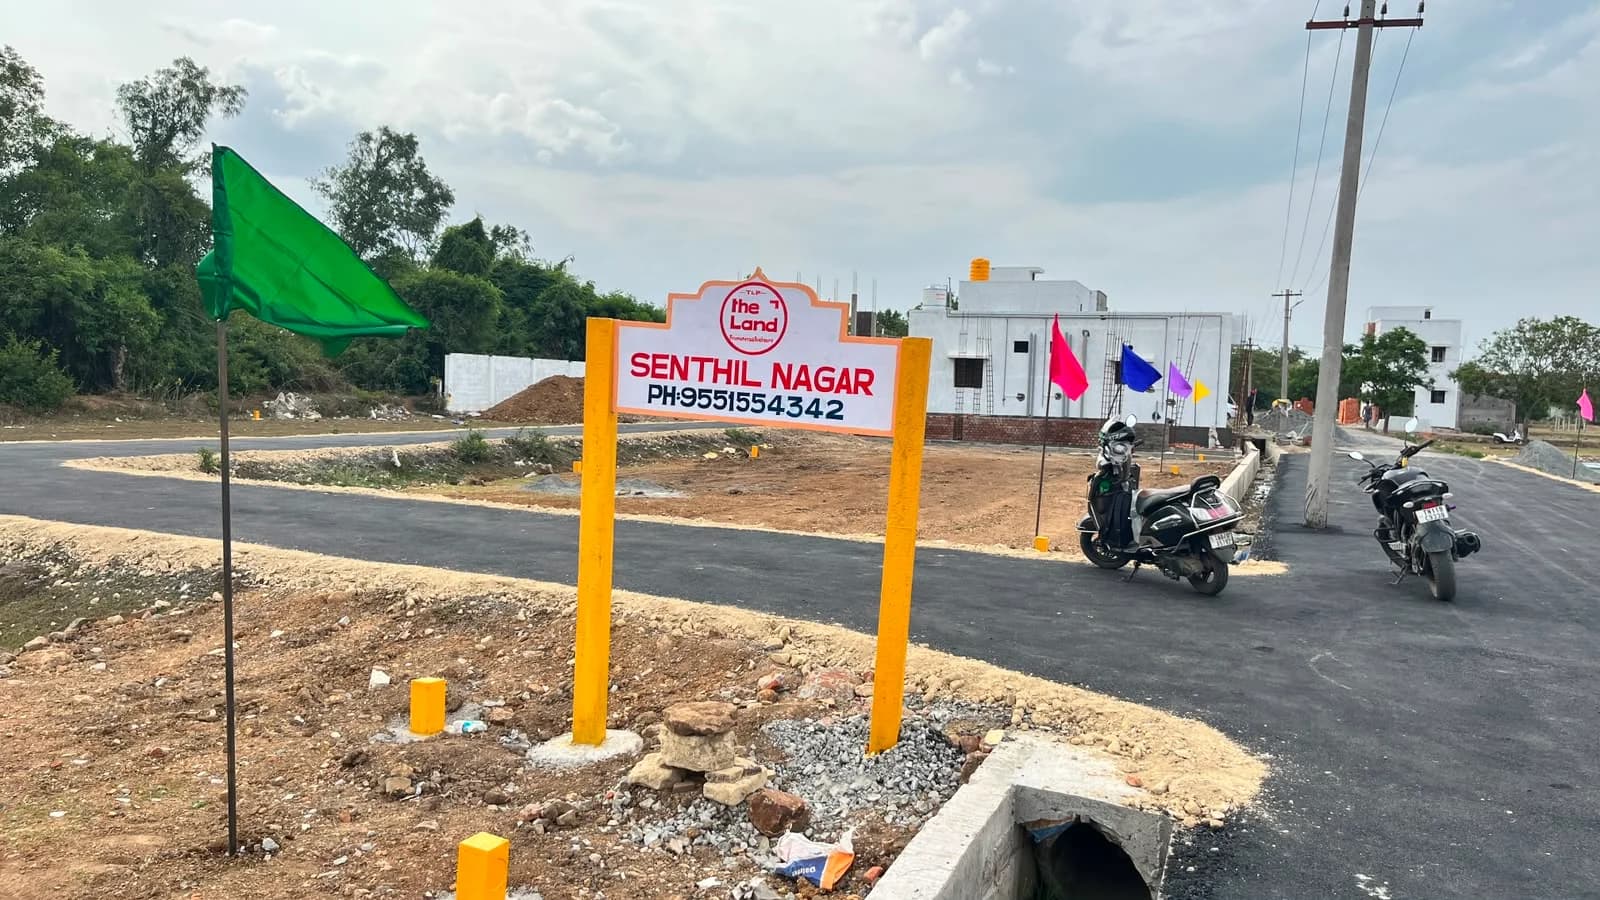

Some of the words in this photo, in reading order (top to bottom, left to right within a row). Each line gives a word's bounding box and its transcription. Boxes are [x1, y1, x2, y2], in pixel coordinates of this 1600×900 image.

[732, 299, 759, 314] the
[730, 315, 777, 332] Land
[631, 352, 761, 387] SENTHIL
[771, 362, 874, 396] NAGAR
[648, 384, 844, 420] PH:9551554342
